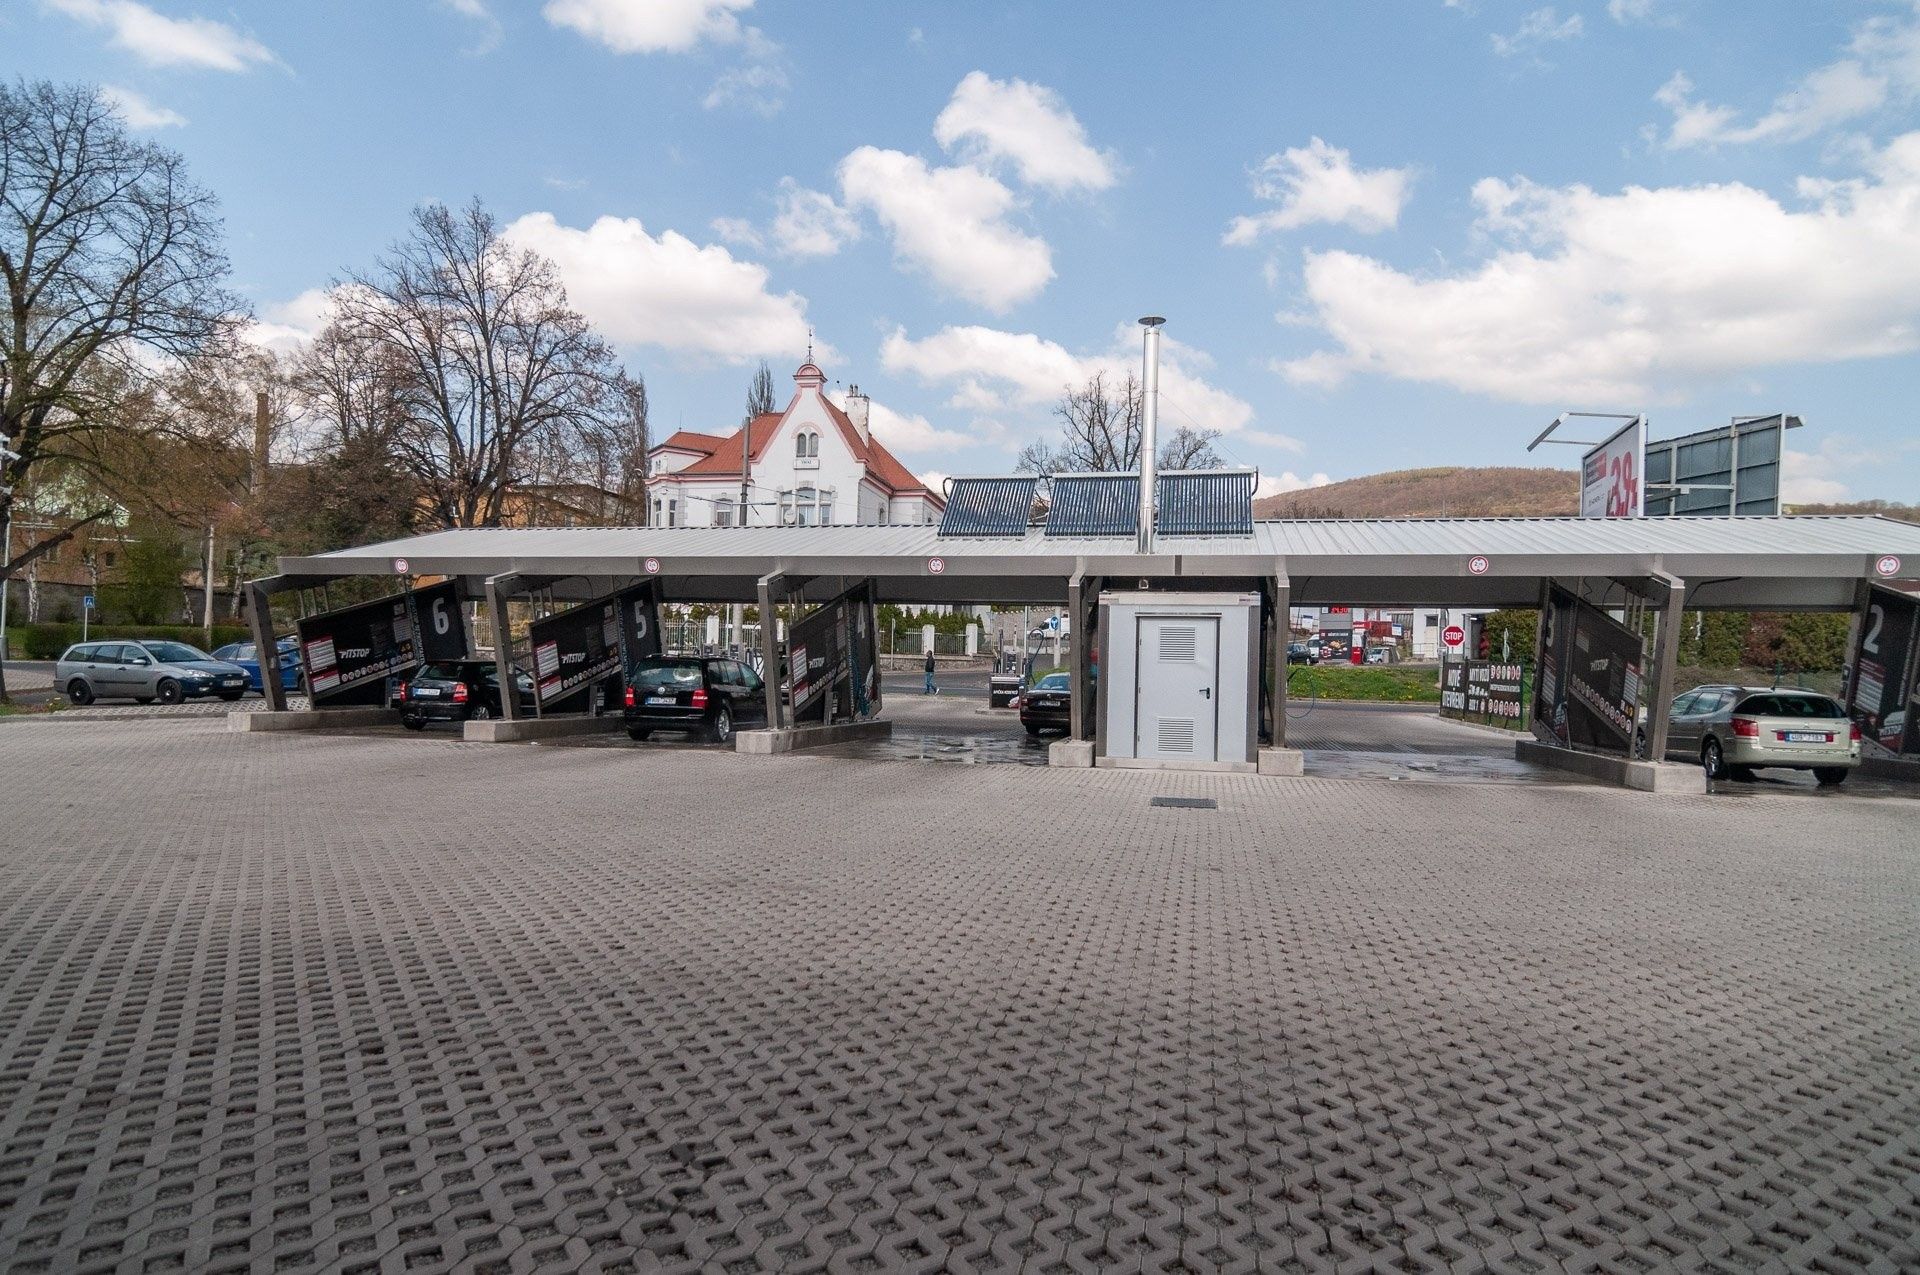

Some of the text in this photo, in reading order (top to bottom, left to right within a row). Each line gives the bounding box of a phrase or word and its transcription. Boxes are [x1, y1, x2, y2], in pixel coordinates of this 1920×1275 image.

[432, 597, 450, 635] 6
[634, 599, 647, 639] 5
[857, 600, 866, 639] 4
[1545, 601, 1556, 648] 3
[1862, 603, 1884, 655] 2
[338, 648, 371, 659] PITSTOP
[1445, 631, 1463, 641] STOP
[561, 652, 586, 664] PITSTOP
